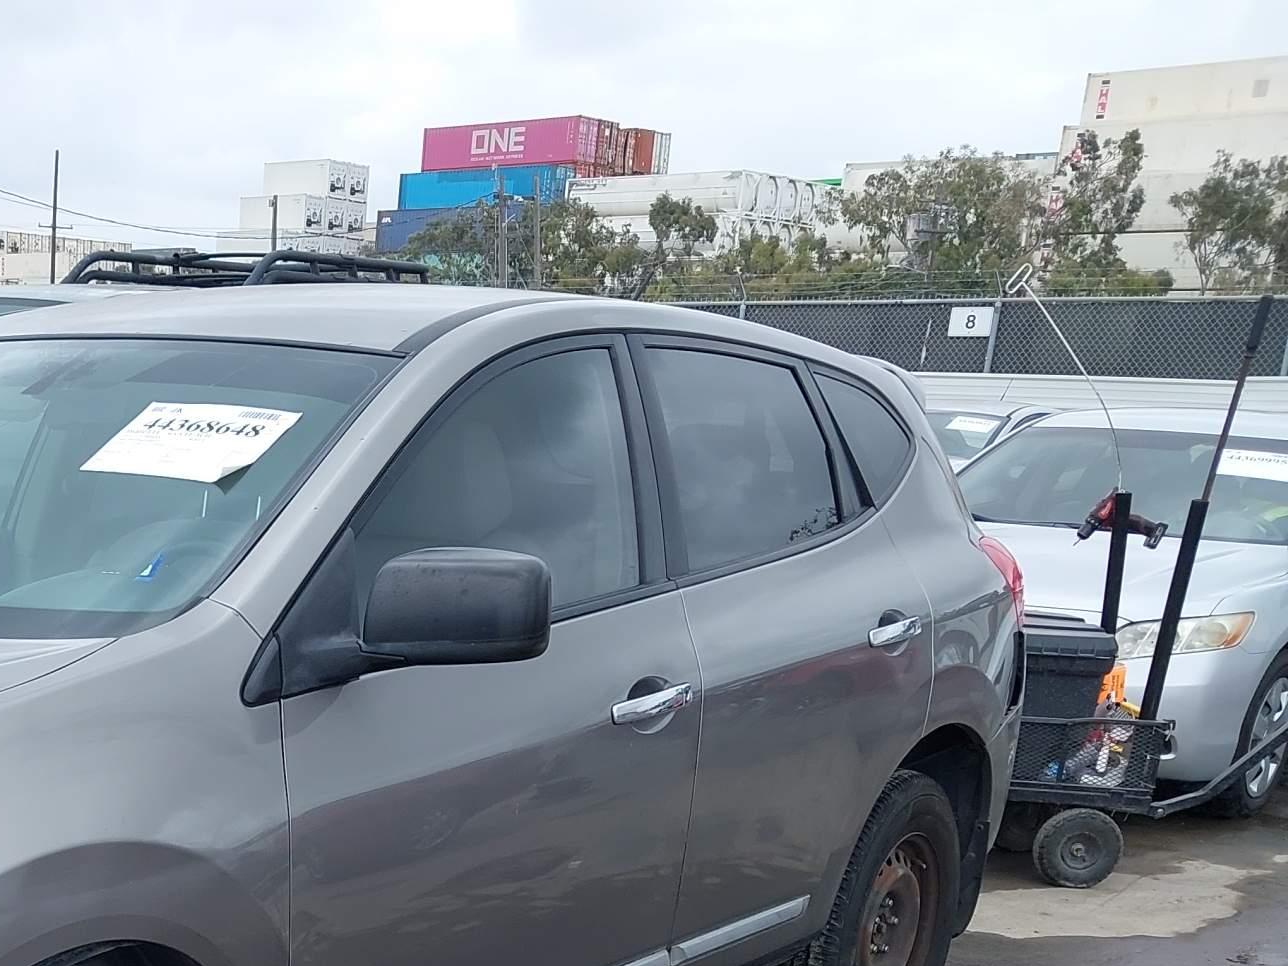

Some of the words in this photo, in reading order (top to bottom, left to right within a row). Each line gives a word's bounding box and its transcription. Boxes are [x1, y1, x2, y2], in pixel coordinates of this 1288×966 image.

[470, 127, 527, 155] ONE
[965, 314, 976, 329] 8
[144, 418, 266, 438] 44368648
